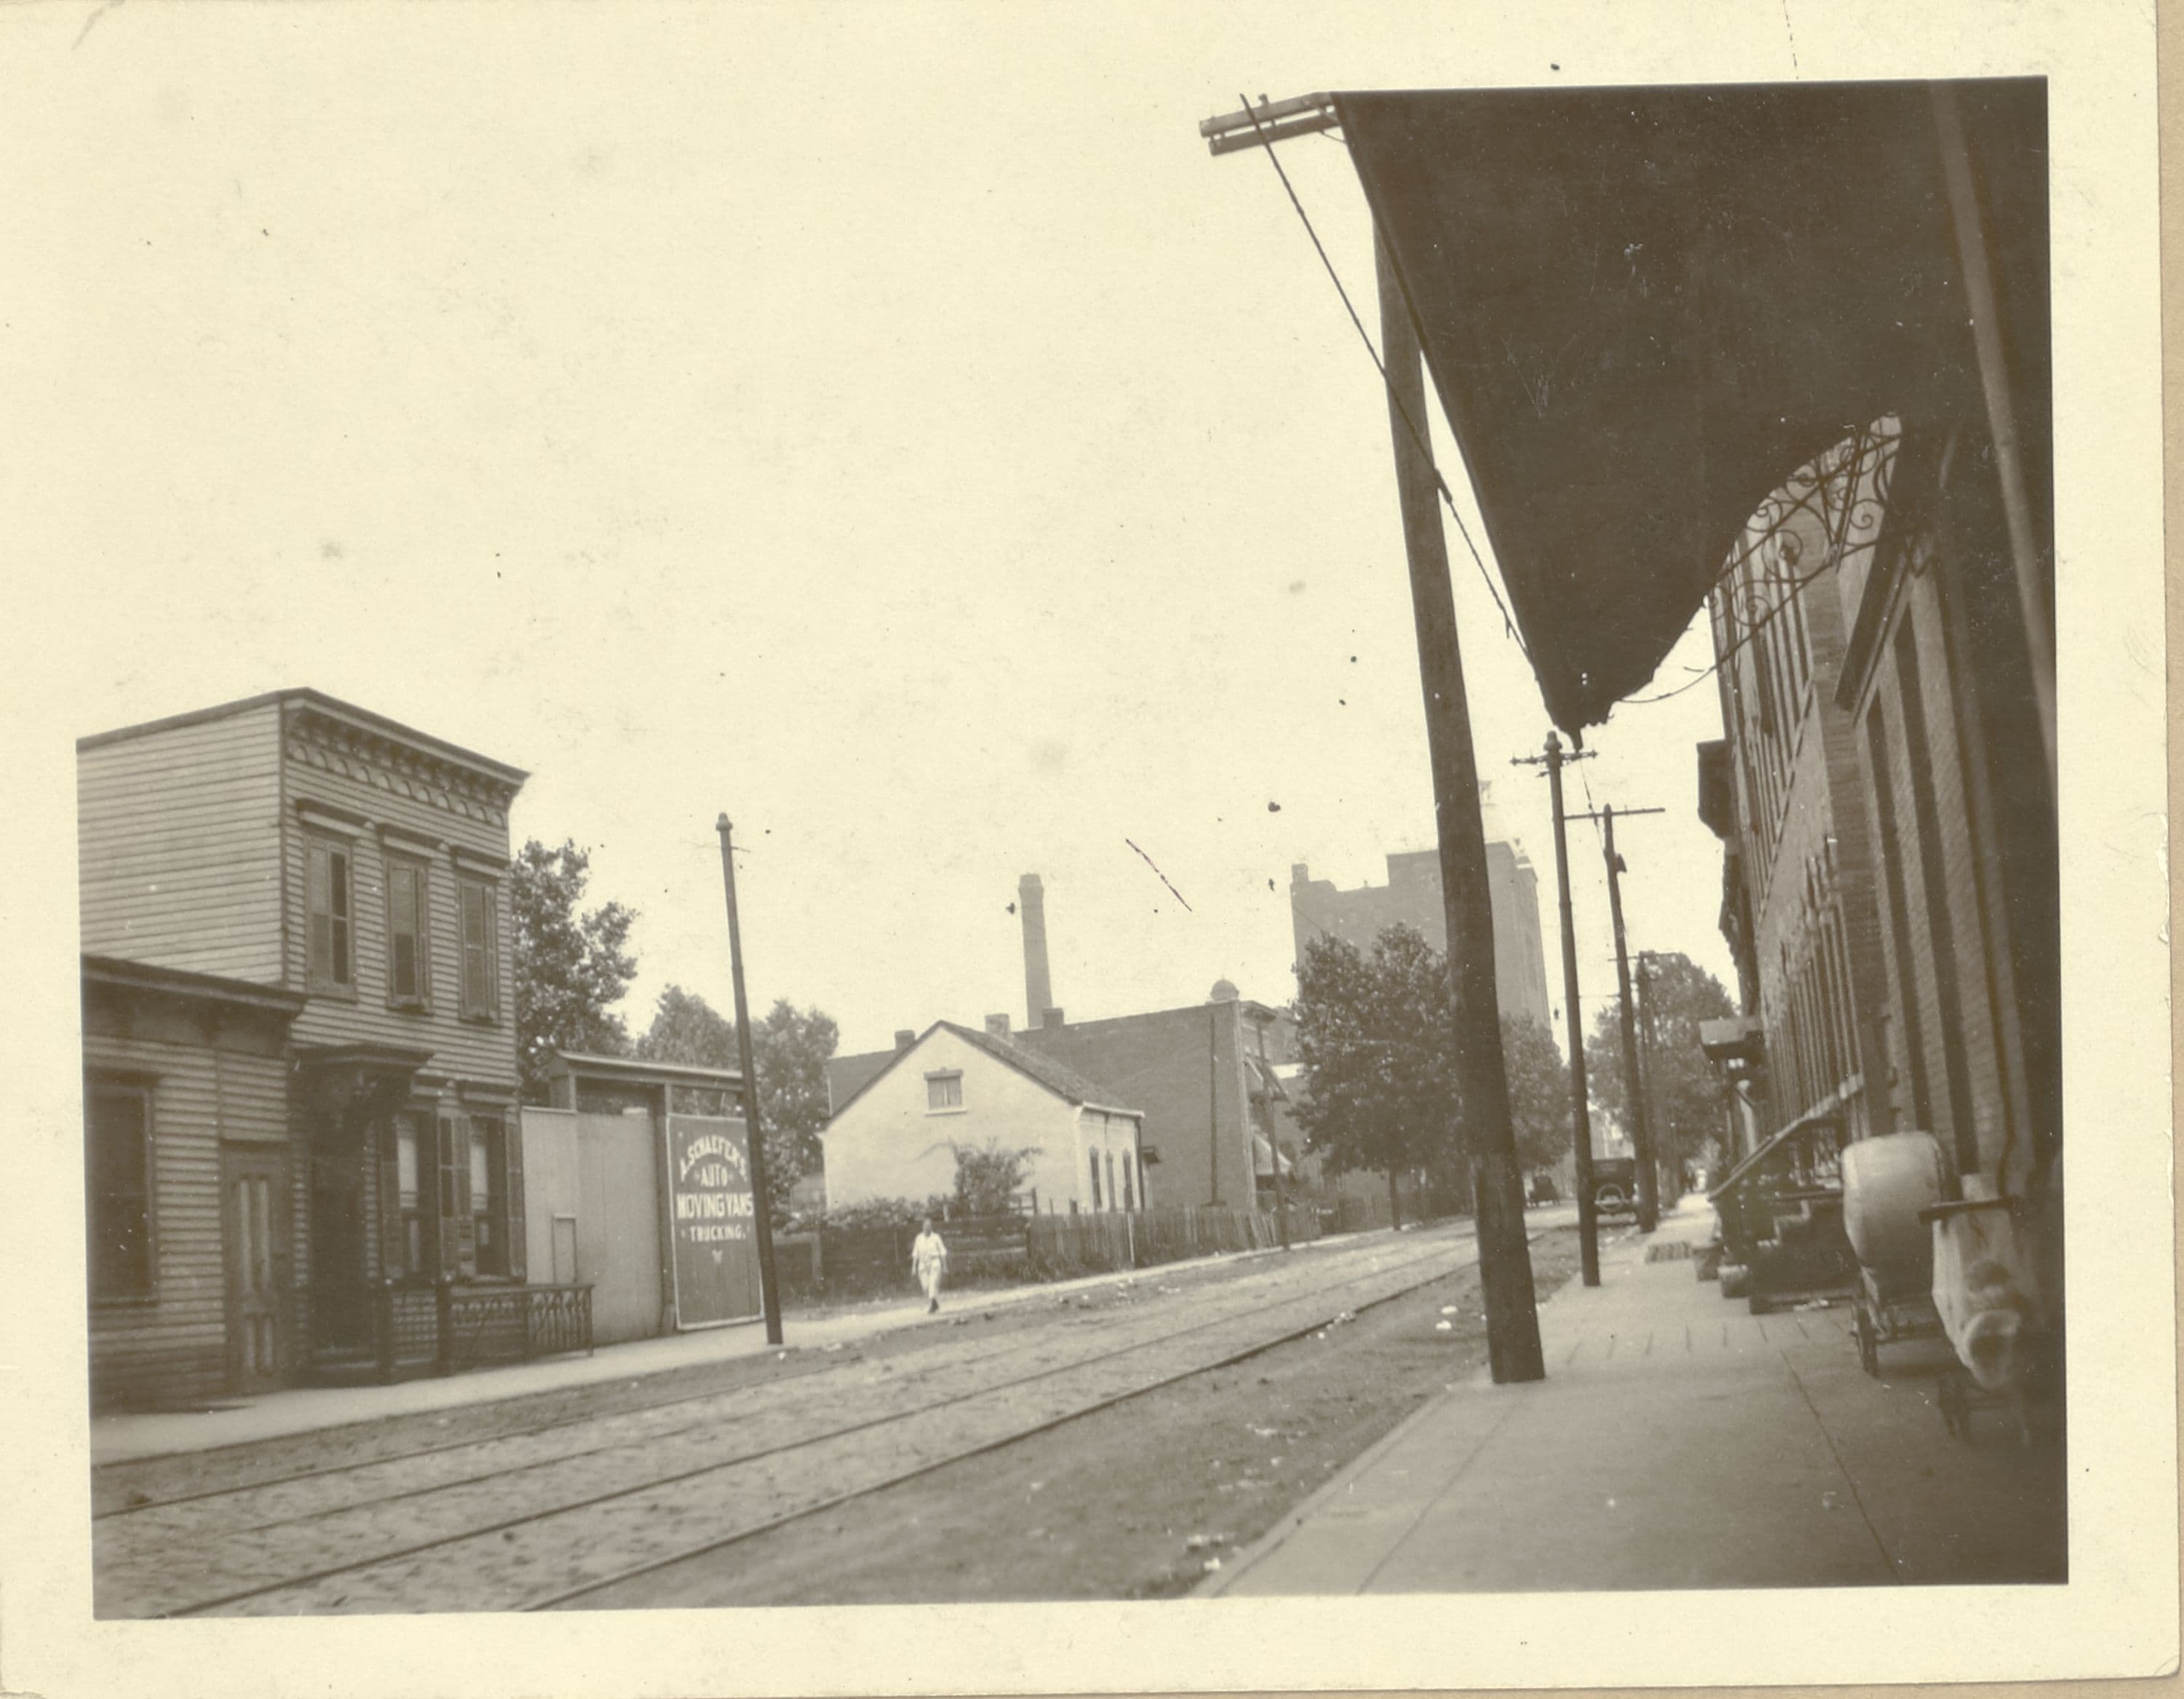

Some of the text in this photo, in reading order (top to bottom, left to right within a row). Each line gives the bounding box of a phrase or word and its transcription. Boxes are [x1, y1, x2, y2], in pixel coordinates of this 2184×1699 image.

[701, 1165, 728, 1187] AUTO
[677, 1192, 753, 1219] MOVING VANS
